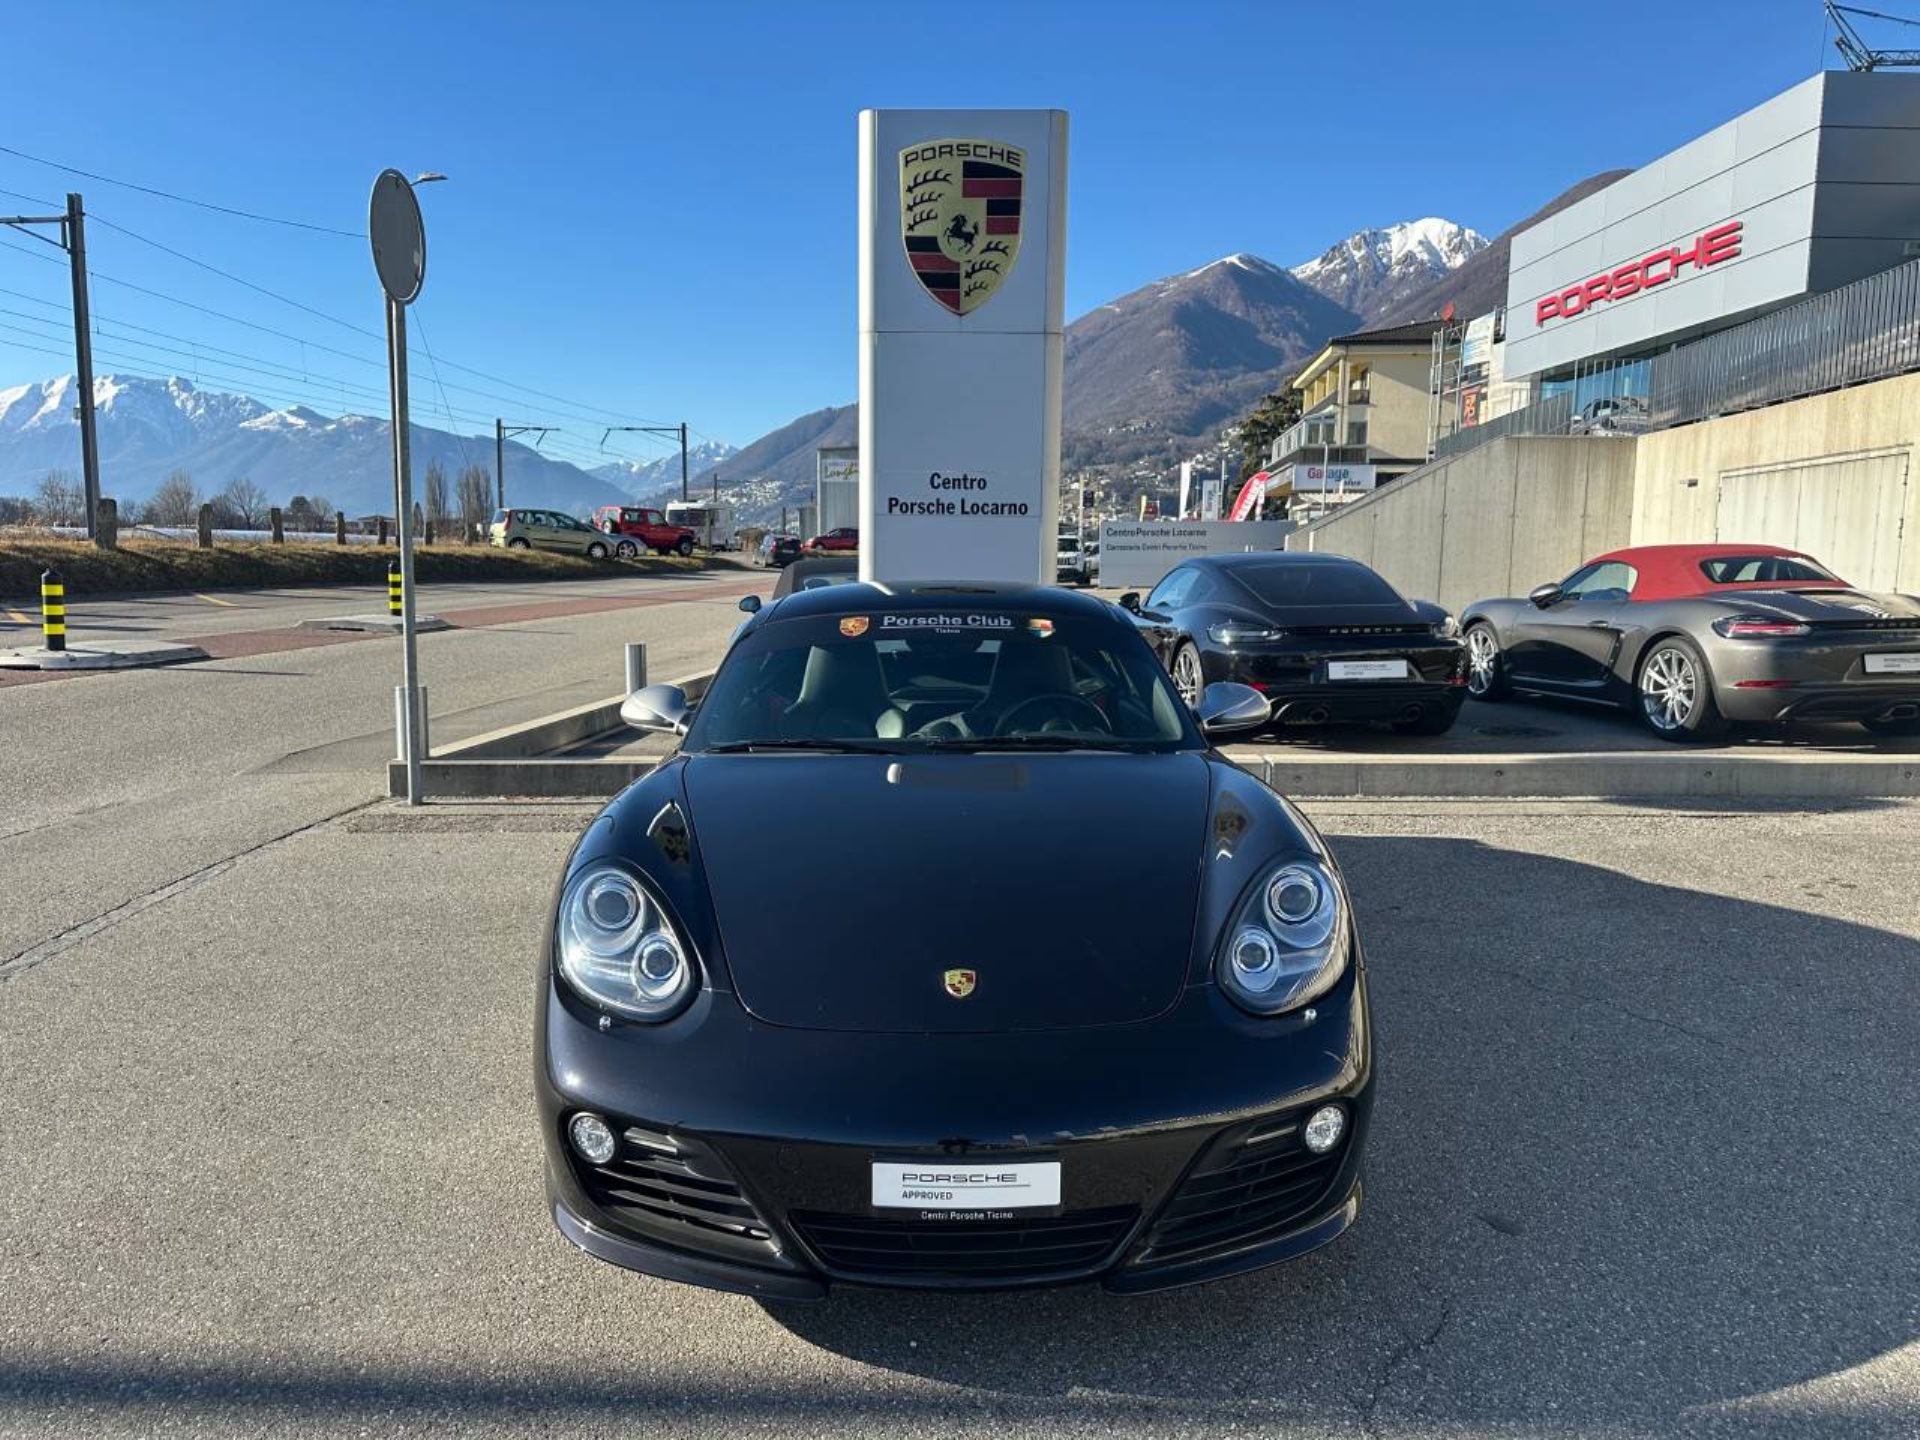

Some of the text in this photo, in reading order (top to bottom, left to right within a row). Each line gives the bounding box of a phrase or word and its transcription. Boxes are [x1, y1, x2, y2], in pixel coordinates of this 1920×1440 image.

[905, 143, 1021, 168] PORSCHE
[1536, 221, 1743, 328] PORSCHE
[929, 472, 988, 490] Centro
[888, 497, 1028, 515] Porsche Locarno
[883, 615, 1012, 627] Porsche Club
[902, 1173, 1018, 1183] PORSCHE
[902, 1191, 953, 1200] APPROVED
[921, 1211, 1013, 1220] Centri Porsche Ticino
